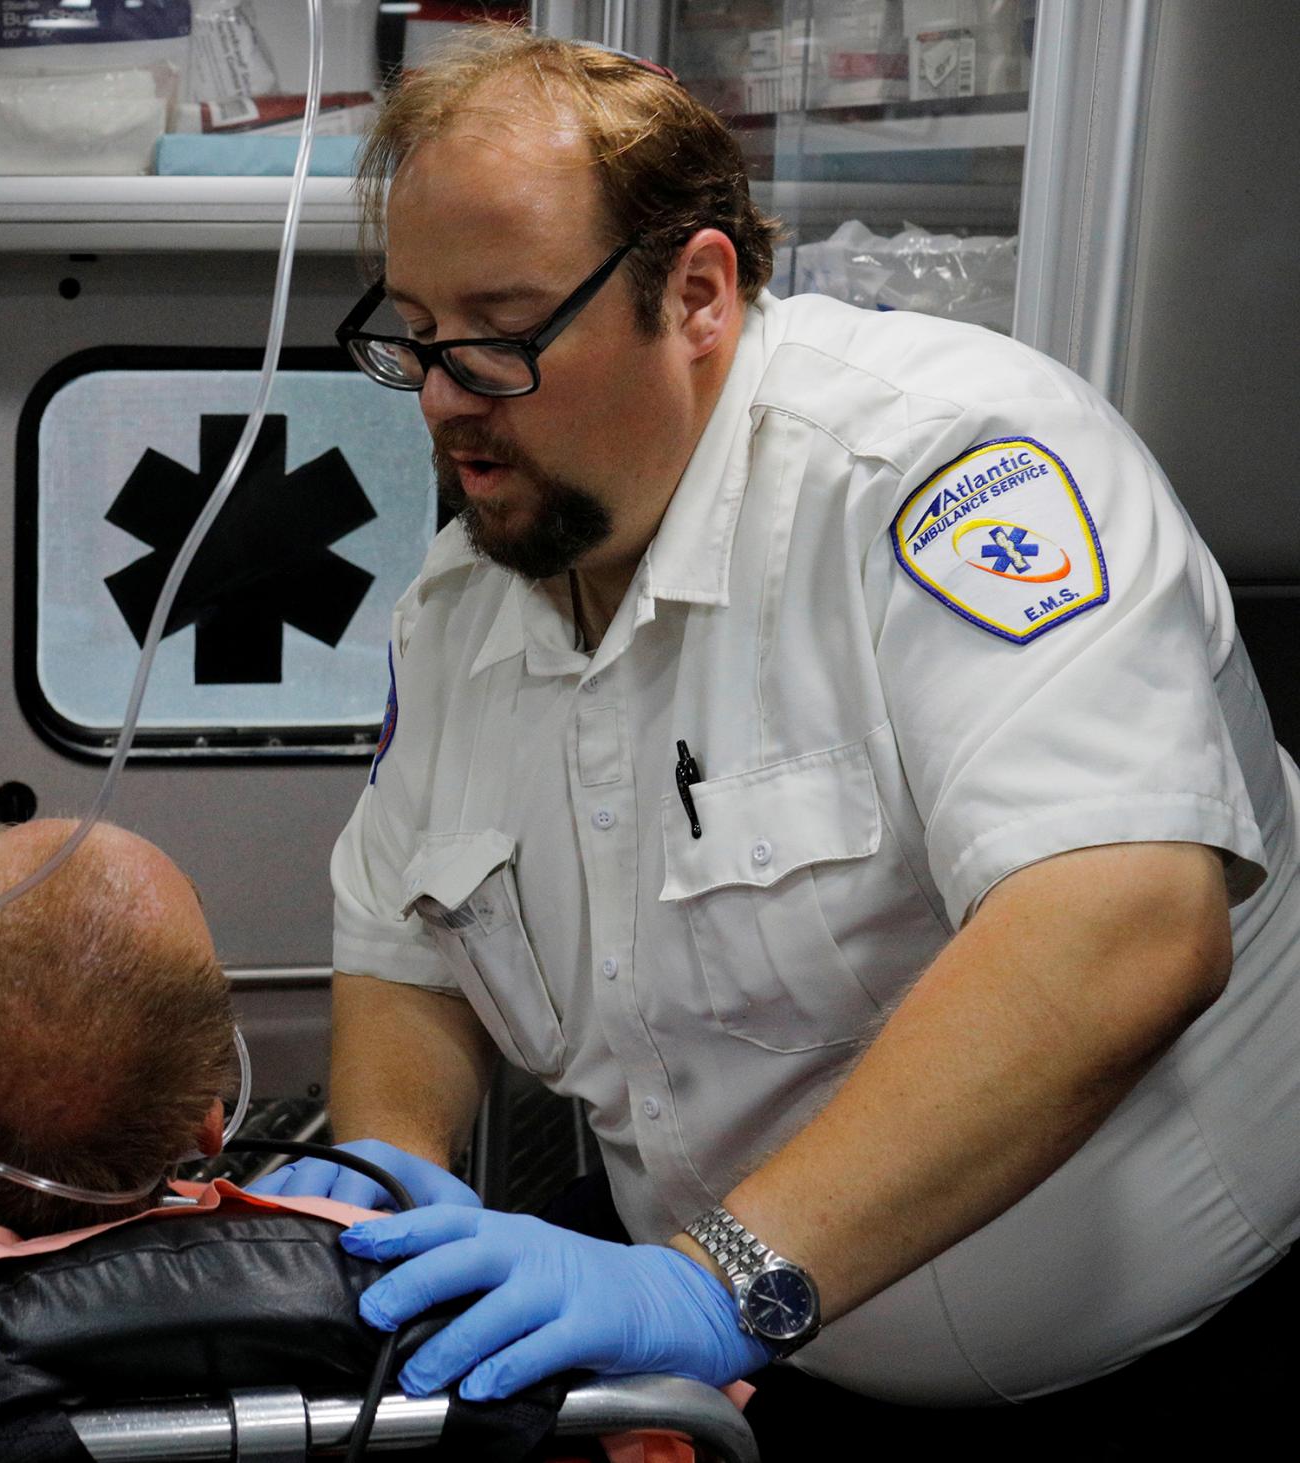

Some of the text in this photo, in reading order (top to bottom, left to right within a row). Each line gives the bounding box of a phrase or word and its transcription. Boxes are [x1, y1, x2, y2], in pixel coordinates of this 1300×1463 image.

[913, 463, 1049, 556] AMBULANCE SERVICE
[930, 451, 1032, 514] Atlantic
[1023, 587, 1080, 623] E.M.S.
